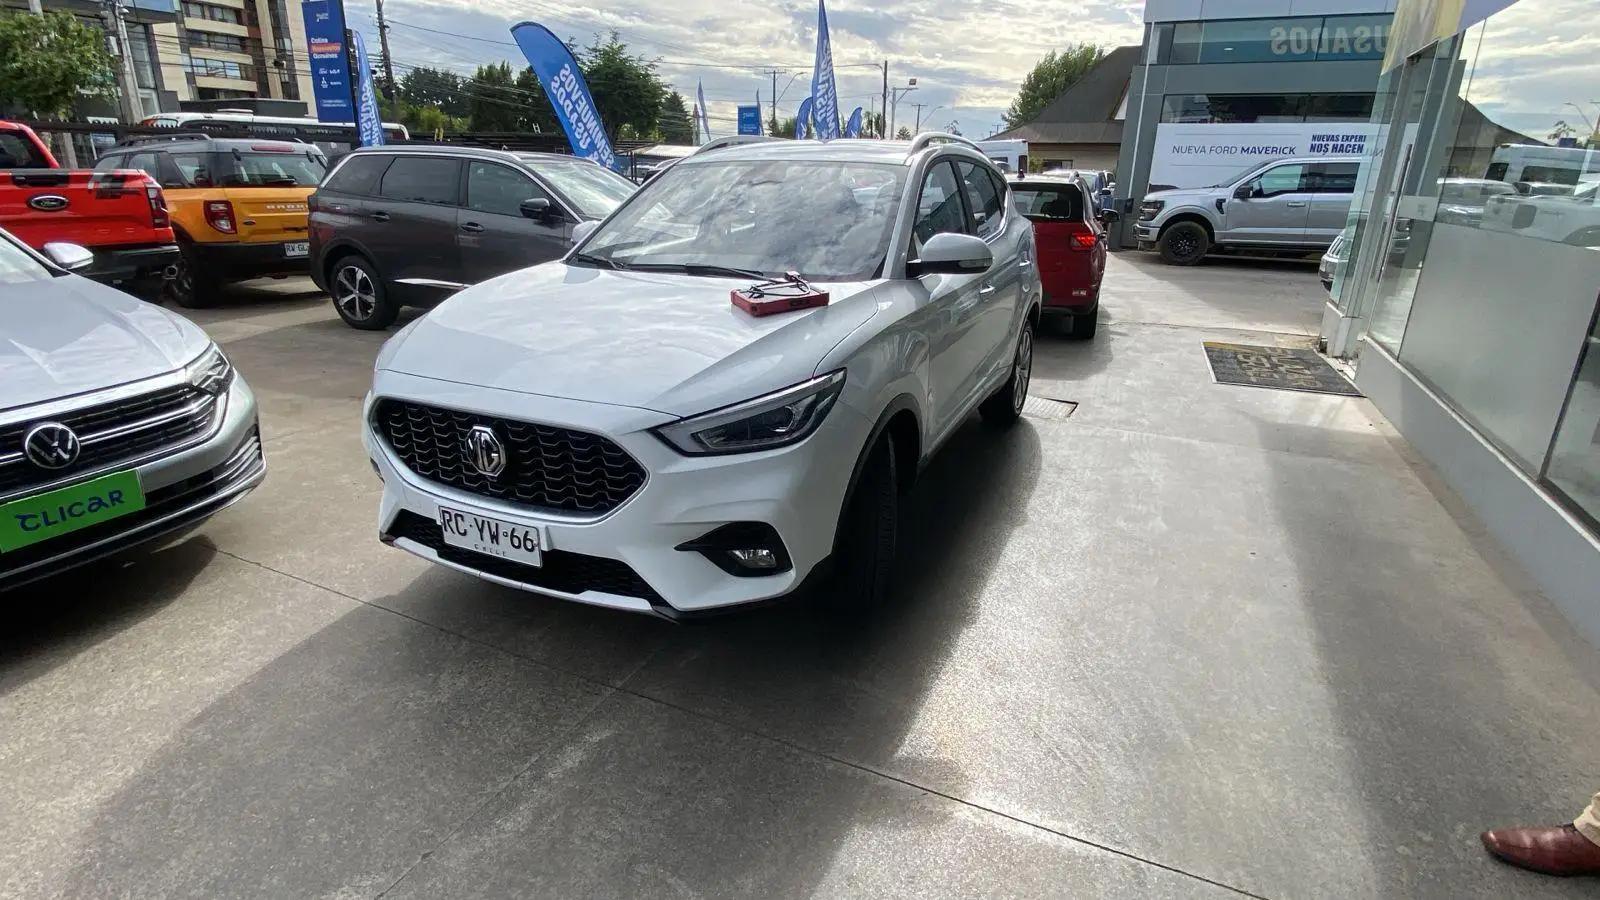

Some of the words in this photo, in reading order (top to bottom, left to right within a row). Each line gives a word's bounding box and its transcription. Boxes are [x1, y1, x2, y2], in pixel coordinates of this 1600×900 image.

[1311, 134, 1340, 142] NUEVAS
[1171, 145, 1207, 155] NUEVA
[1208, 145, 1238, 155] FORD
[1240, 146, 1297, 155] MAVERICK
[1331, 143, 1364, 154] HACEN
